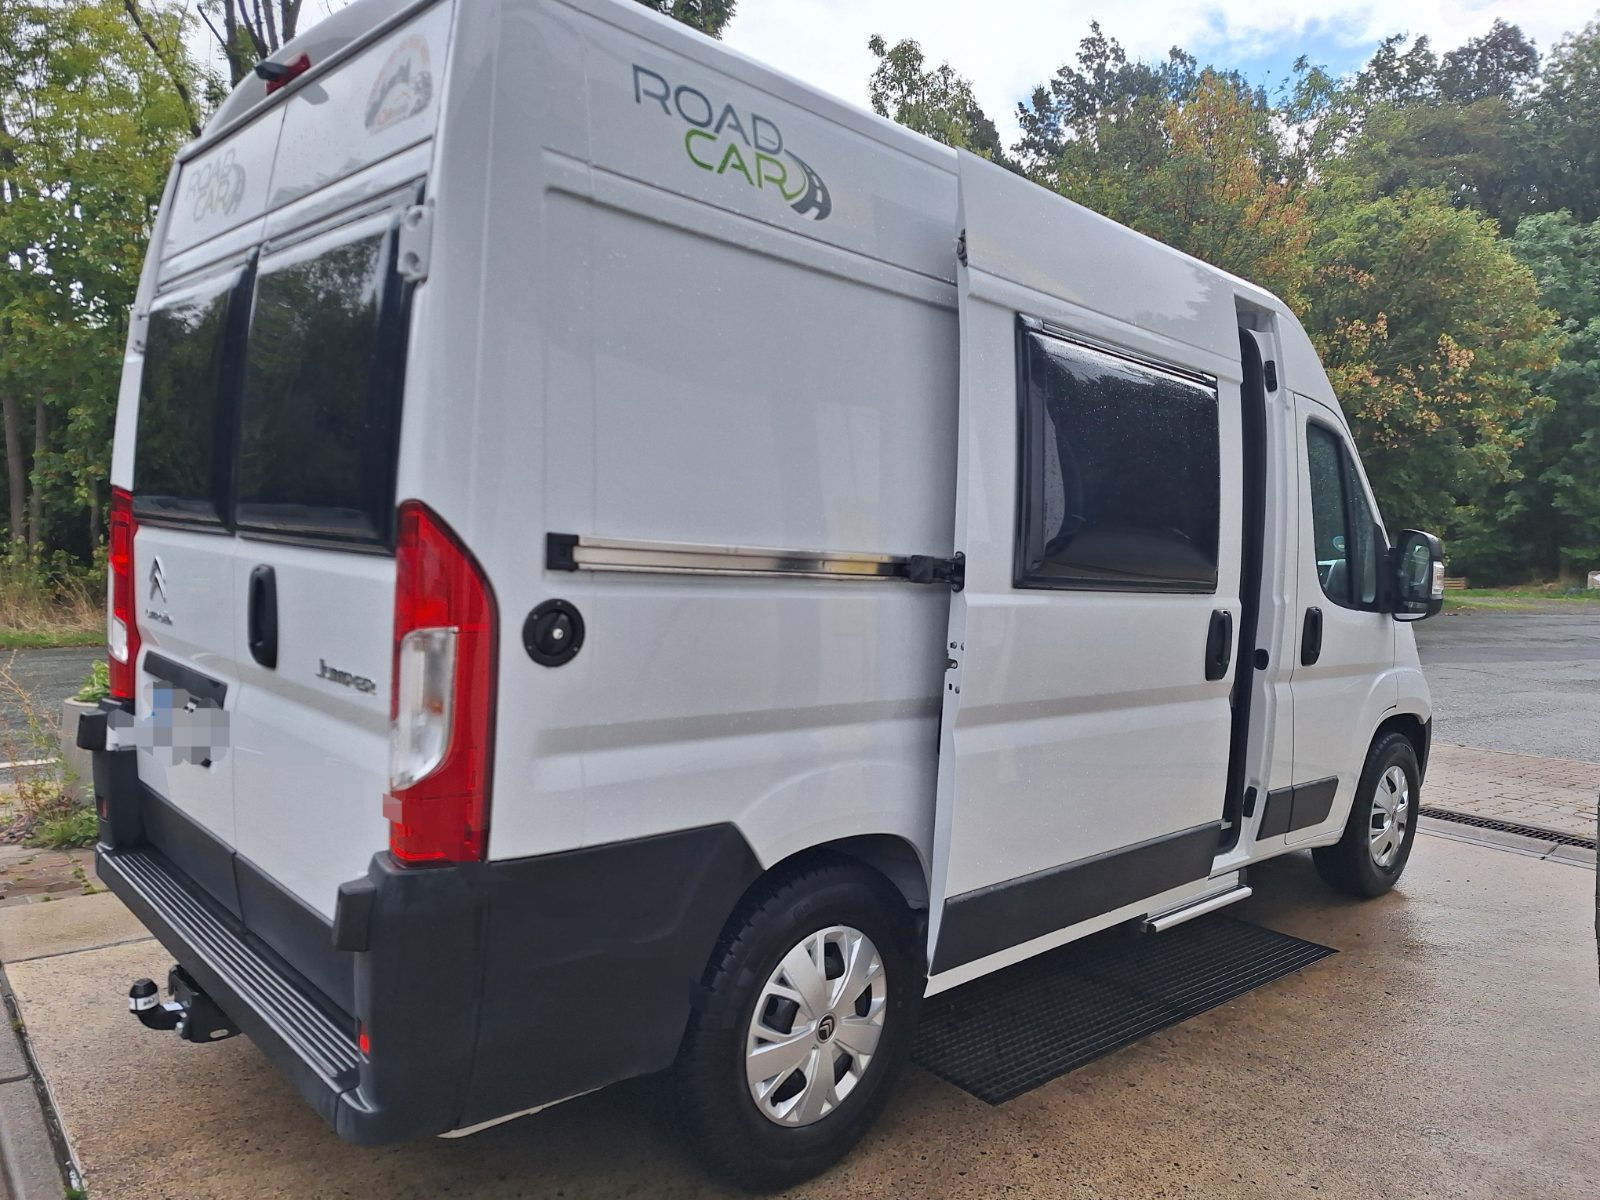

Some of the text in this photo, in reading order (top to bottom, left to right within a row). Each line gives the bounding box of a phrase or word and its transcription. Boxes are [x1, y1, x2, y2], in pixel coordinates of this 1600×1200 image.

[632, 63, 783, 155] ROAD
[186, 148, 236, 200] ROAD
[685, 129, 803, 201] CAR
